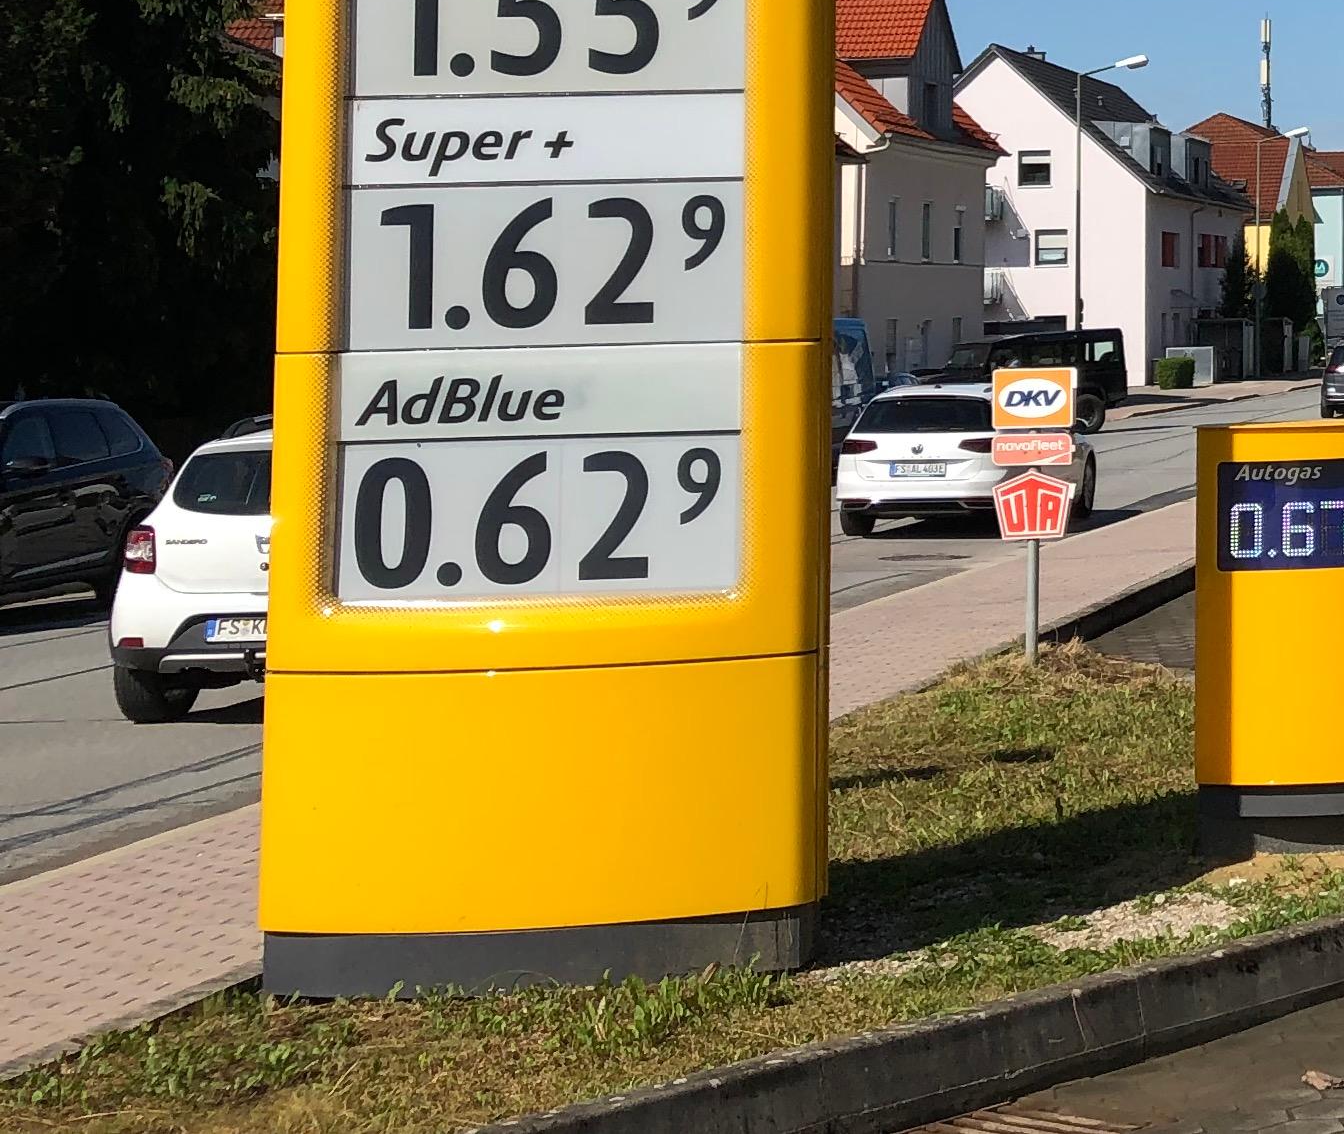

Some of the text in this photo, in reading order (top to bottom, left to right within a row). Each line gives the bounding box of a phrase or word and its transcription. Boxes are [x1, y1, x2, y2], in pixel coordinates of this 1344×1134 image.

[364, 118, 574, 178] Super +
[379, 194, 726, 331] 1.629
[354, 374, 565, 427] AdBlue
[1004, 389, 1062, 408] DKV
[1234, 464, 1323, 486] Autogas
[354, 447, 722, 590] 0.629
[1000, 478, 1064, 533] UTA
[217, 618, 240, 635] FS
